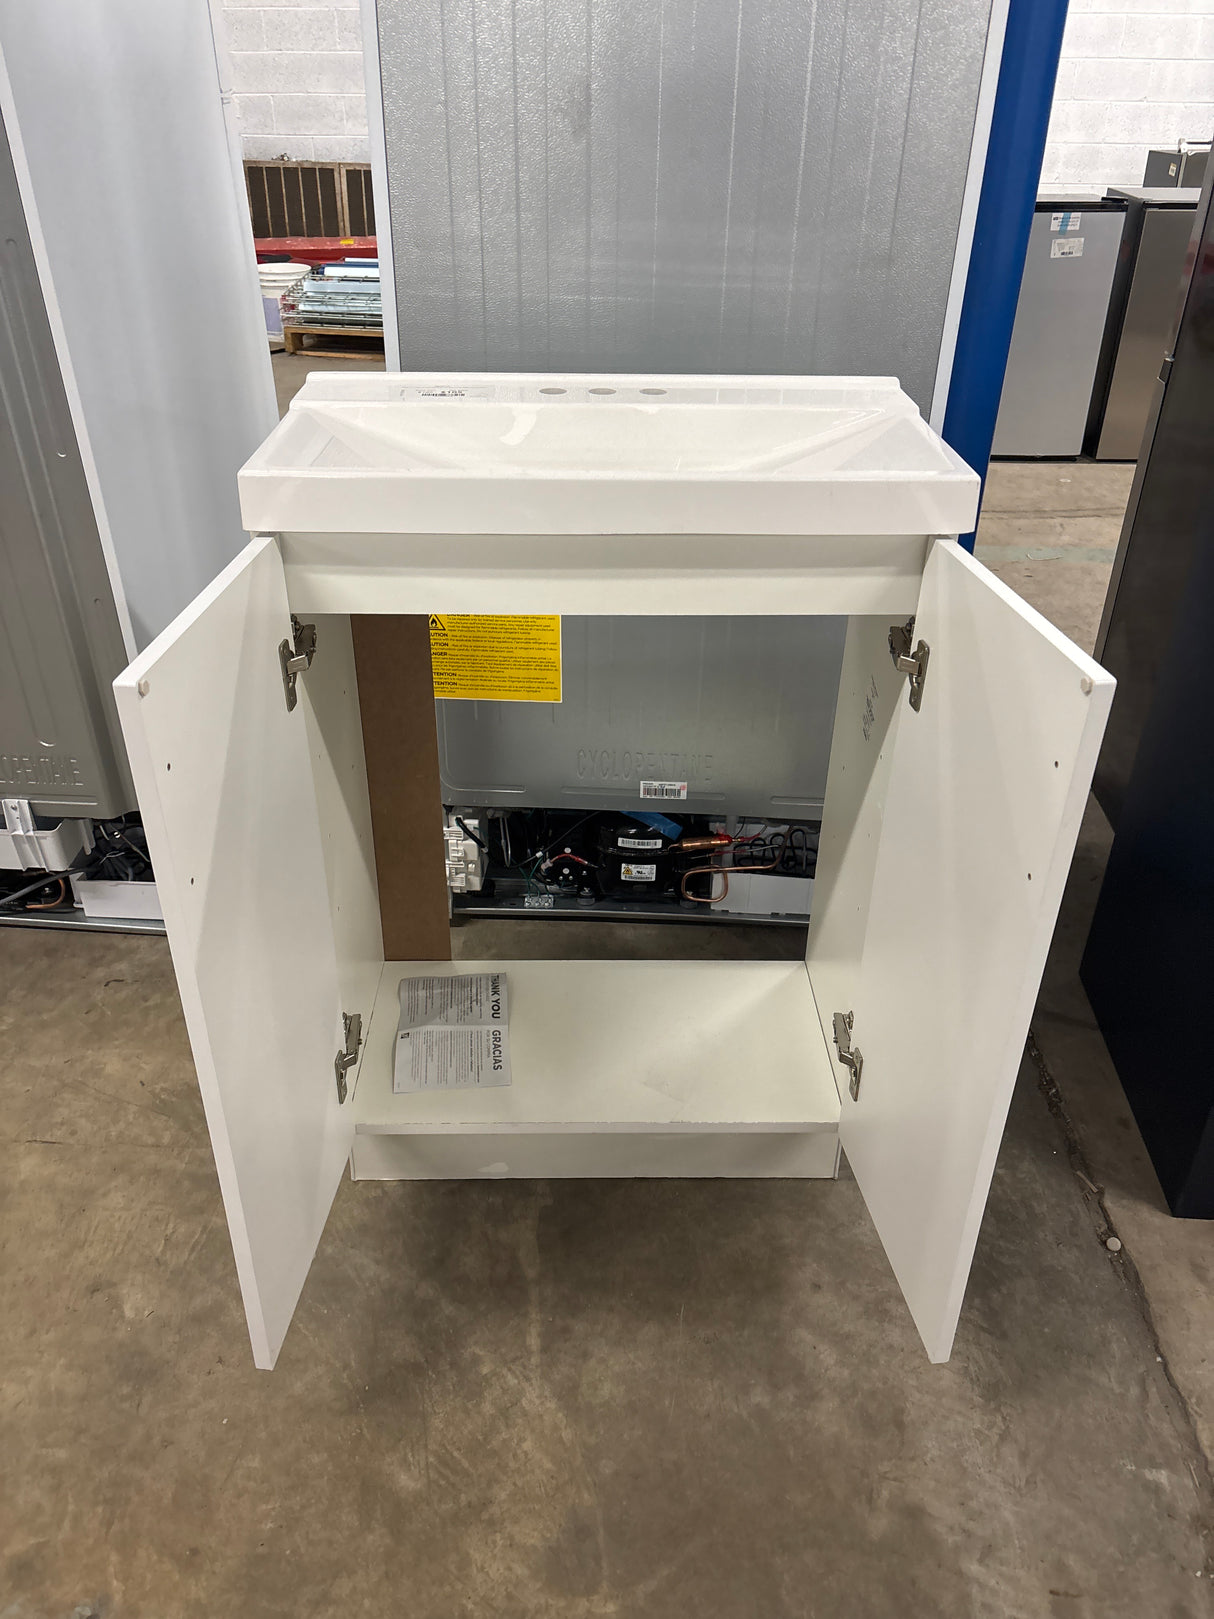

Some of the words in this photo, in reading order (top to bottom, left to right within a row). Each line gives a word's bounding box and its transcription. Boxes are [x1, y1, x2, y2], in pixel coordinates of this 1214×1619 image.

[0, 756, 84, 786] OPENTANE
[577, 749, 713, 781] CYCLOPENTANE
[490, 974, 501, 997] THANK
[491, 998, 501, 1019] YOU
[492, 1029, 503, 1071] GRACIAS
